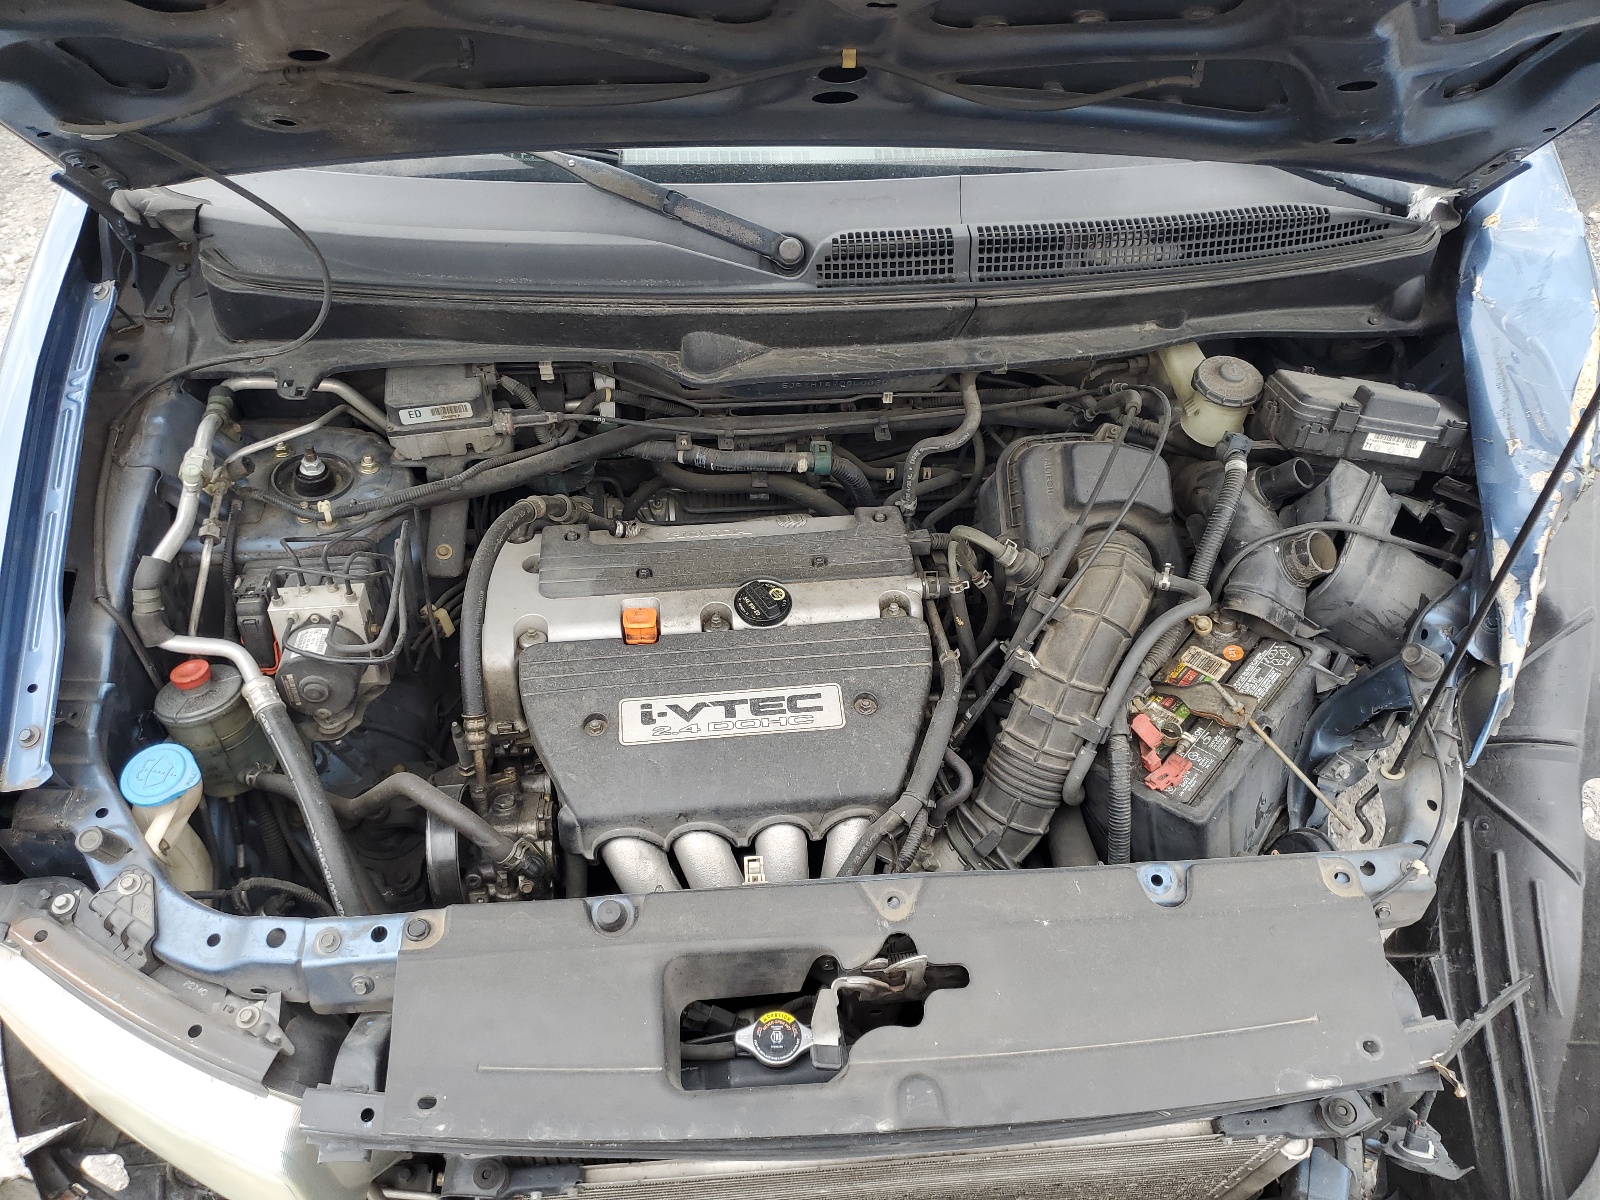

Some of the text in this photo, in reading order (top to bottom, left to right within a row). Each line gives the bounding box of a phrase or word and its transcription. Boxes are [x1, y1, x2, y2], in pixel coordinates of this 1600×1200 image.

[408, 410, 422, 419] ED
[640, 693, 823, 726] i-VTEC
[652, 714, 815, 737] 2.4 DOHC
